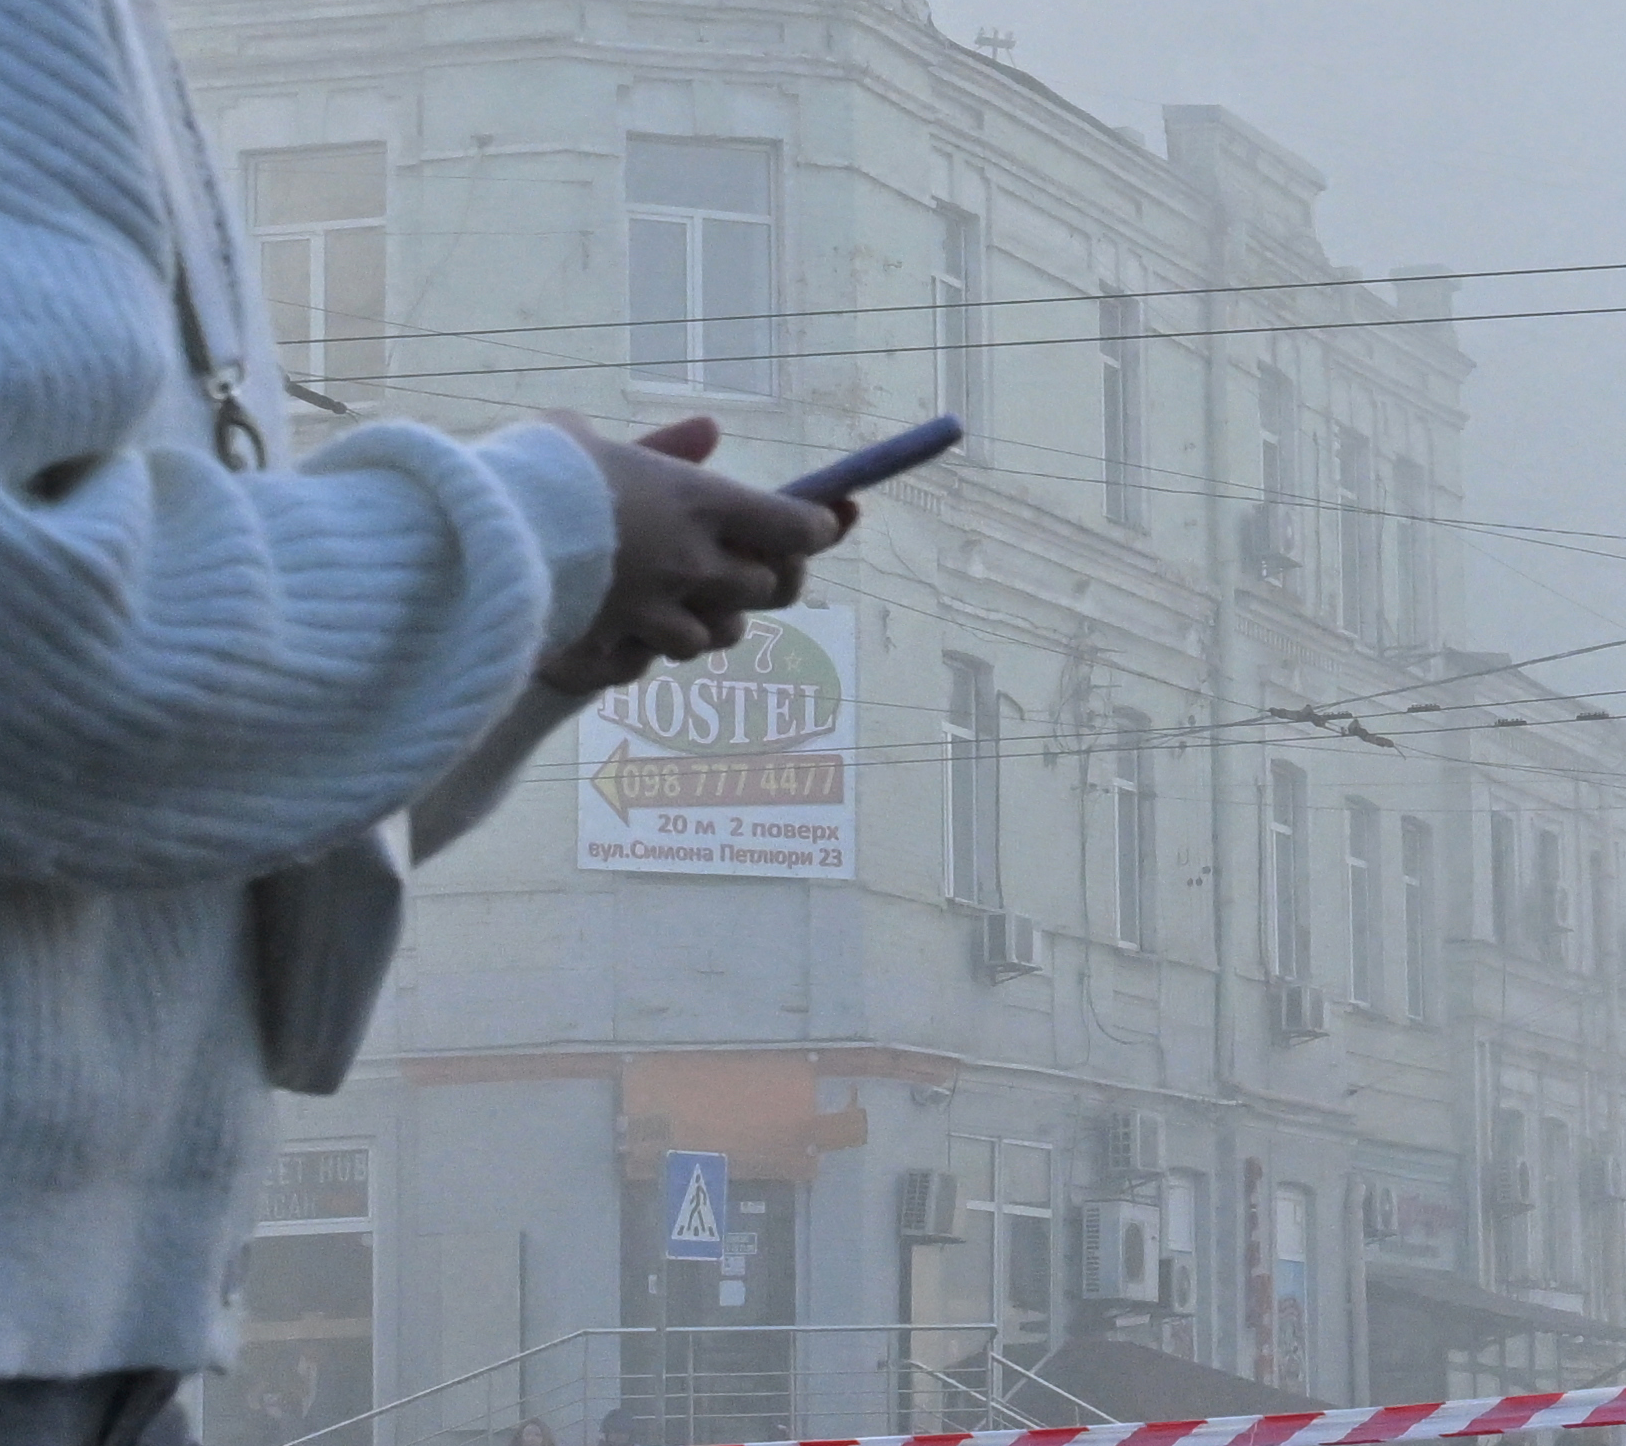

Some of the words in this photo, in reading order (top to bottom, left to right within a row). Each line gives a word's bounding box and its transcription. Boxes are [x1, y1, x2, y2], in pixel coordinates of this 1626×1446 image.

[598, 675, 835, 744] HOSTEL
[623, 764, 681, 798] 098
[691, 763, 749, 796] 777
[760, 761, 836, 796] 4477
[657, 814, 688, 835] 20
[694, 820, 716, 836] м
[729, 817, 744, 837] 2
[752, 821, 840, 844] поверх
[588, 840, 714, 863] вул.Симона
[719, 843, 814, 869] Петлюри
[818, 848, 843, 868] 23
